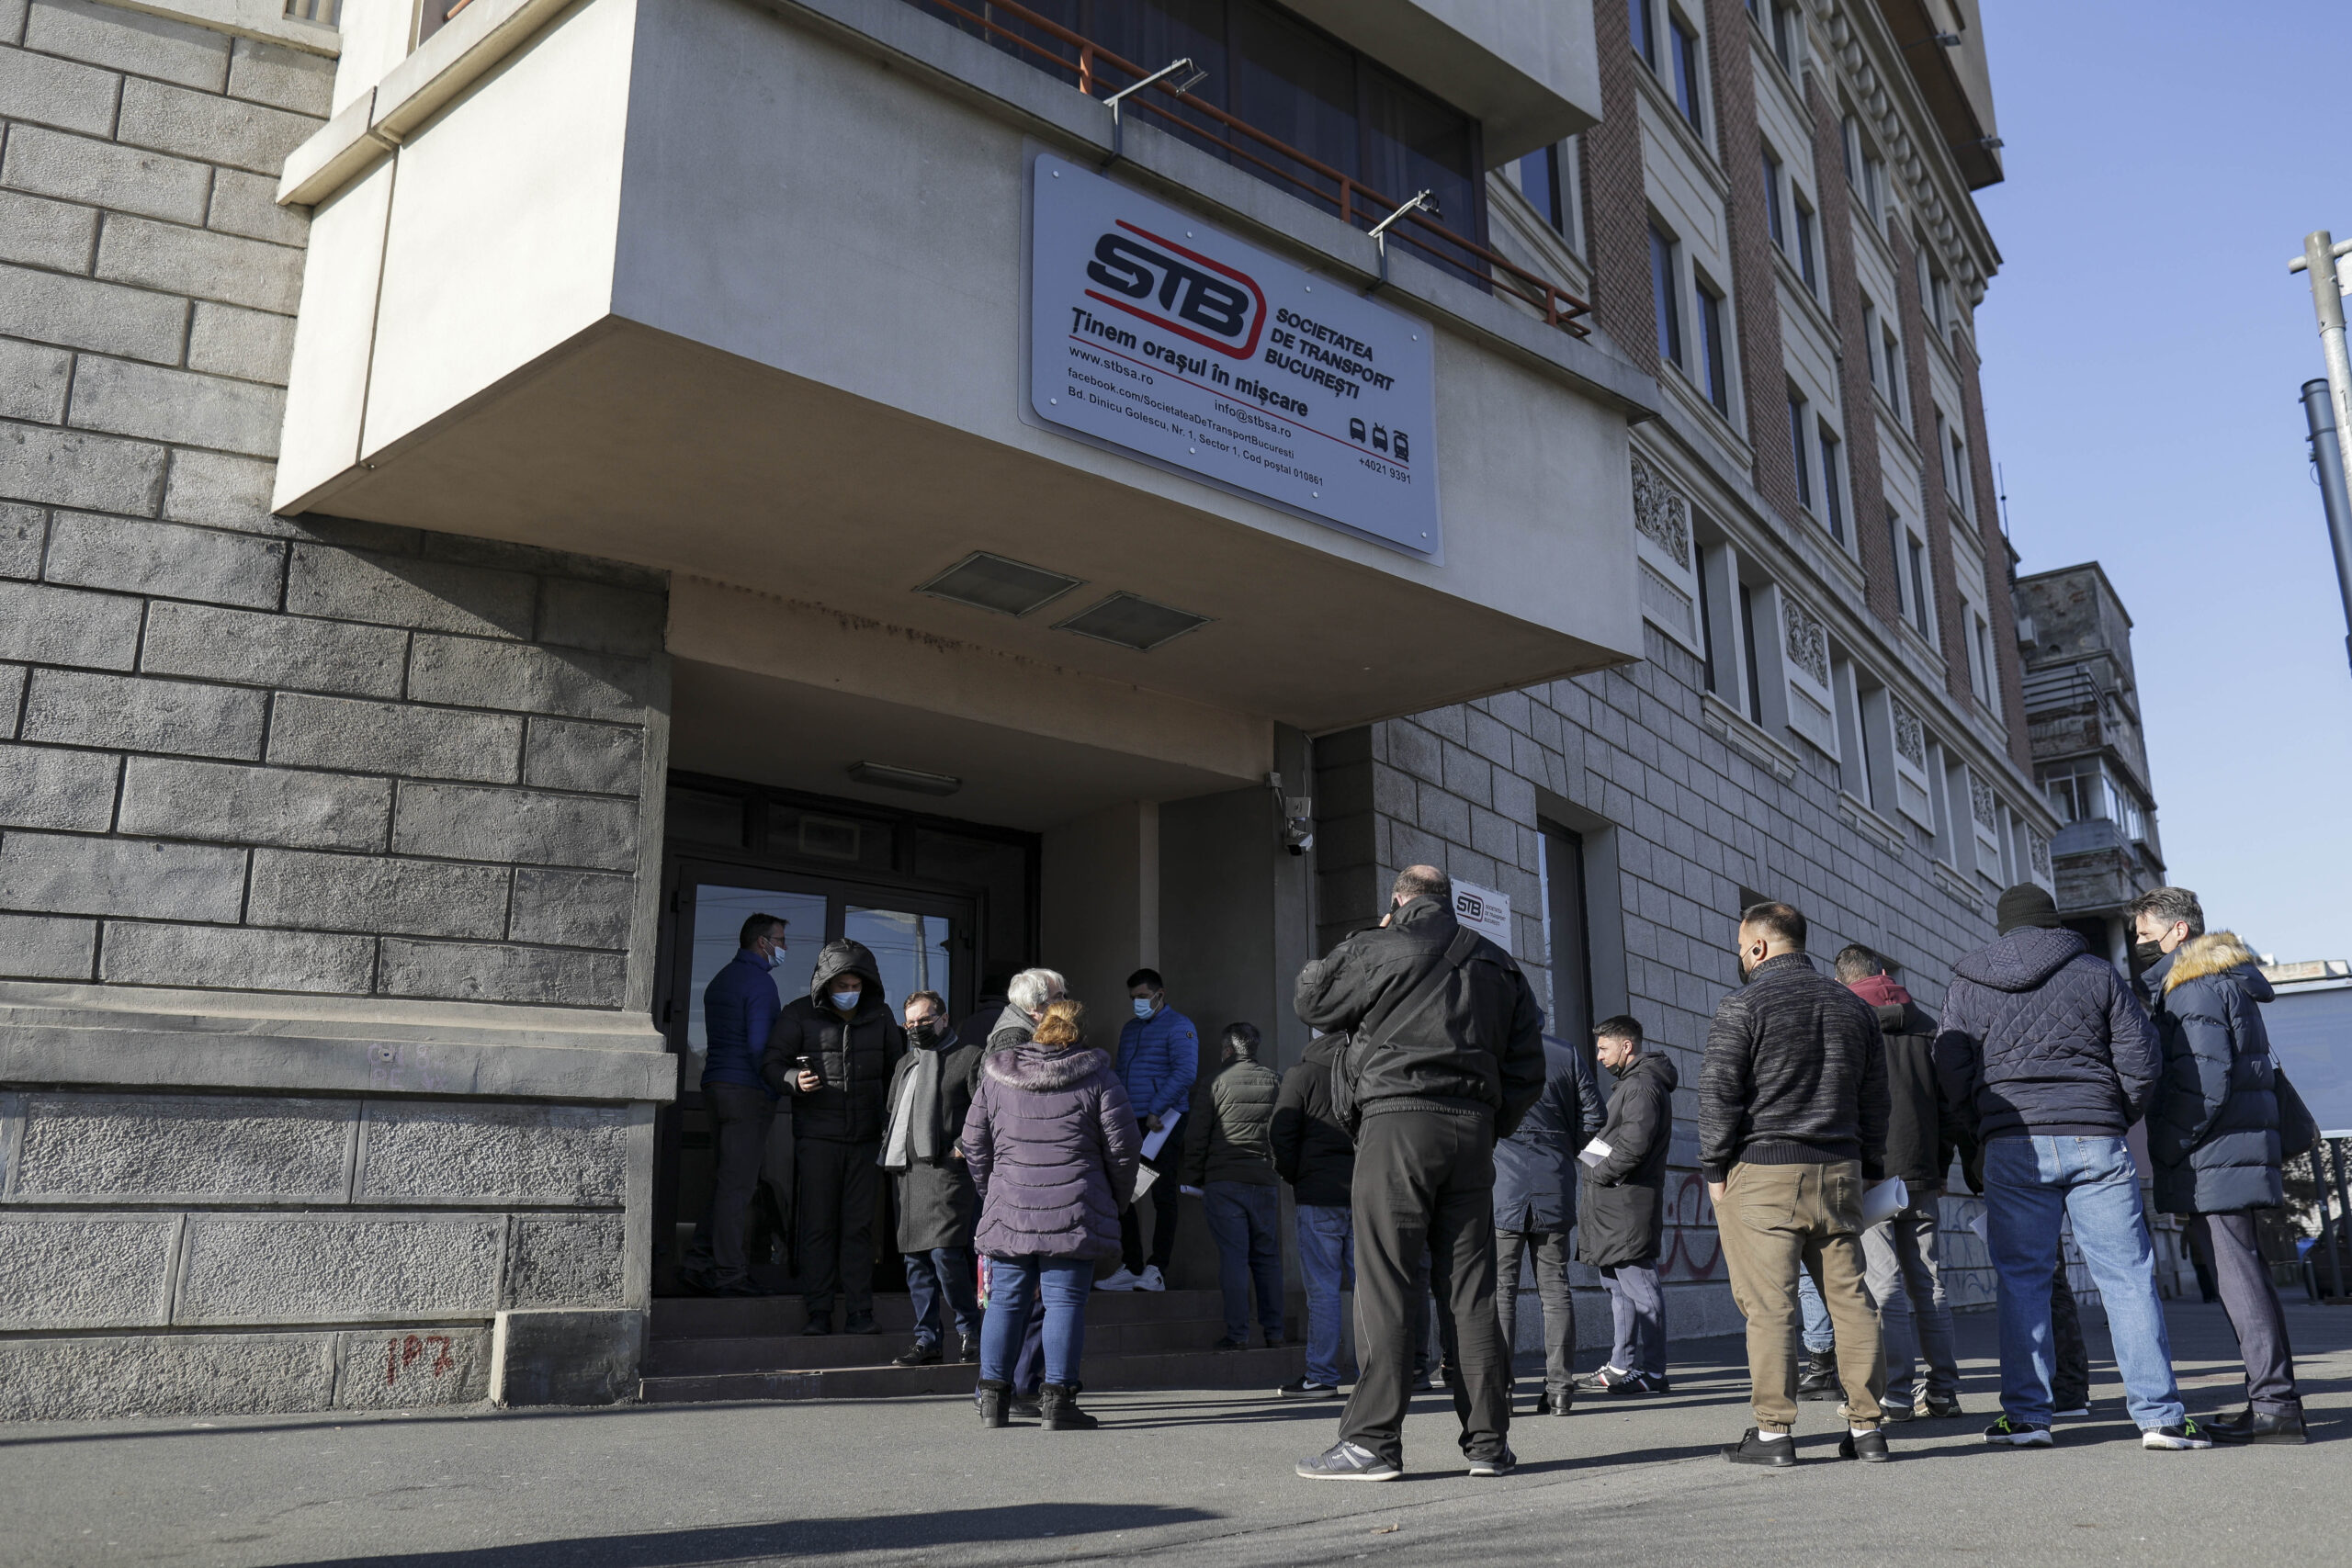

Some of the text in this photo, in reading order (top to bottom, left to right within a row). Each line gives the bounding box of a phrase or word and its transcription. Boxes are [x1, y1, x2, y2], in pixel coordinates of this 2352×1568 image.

[1087, 232, 1250, 337] STB
[1270, 328, 1395, 391] DE TRANSPORT
[1276, 308, 1374, 362] SOCIETATEA
[1069, 346, 1154, 386] www.stbsa.ro
[1071, 308, 1308, 417] Ținem orașul în mișcare
[1264, 348, 1360, 400] BUCUREȘTI
[1068, 367, 1295, 459] facebook.com/SocietateaDeTransportBucuresti
[1068, 387, 1088, 401] Bd.
[1090, 394, 1123, 413] Dinicu
[1125, 407, 1169, 431] Golescu,
[1172, 424, 1188, 439] Nr.
[1188, 431, 1198, 446] 1,
[1198, 434, 1230, 452] Sector
[1232, 446, 1241, 457] 1,
[1243, 450, 1262, 465] Cod
[1294, 468, 1324, 487] 010861
[1214, 400, 1292, 439] info@stbsa.ro
[1359, 457, 1411, 484] +4021 9391
[1456, 896, 1481, 917] STB
